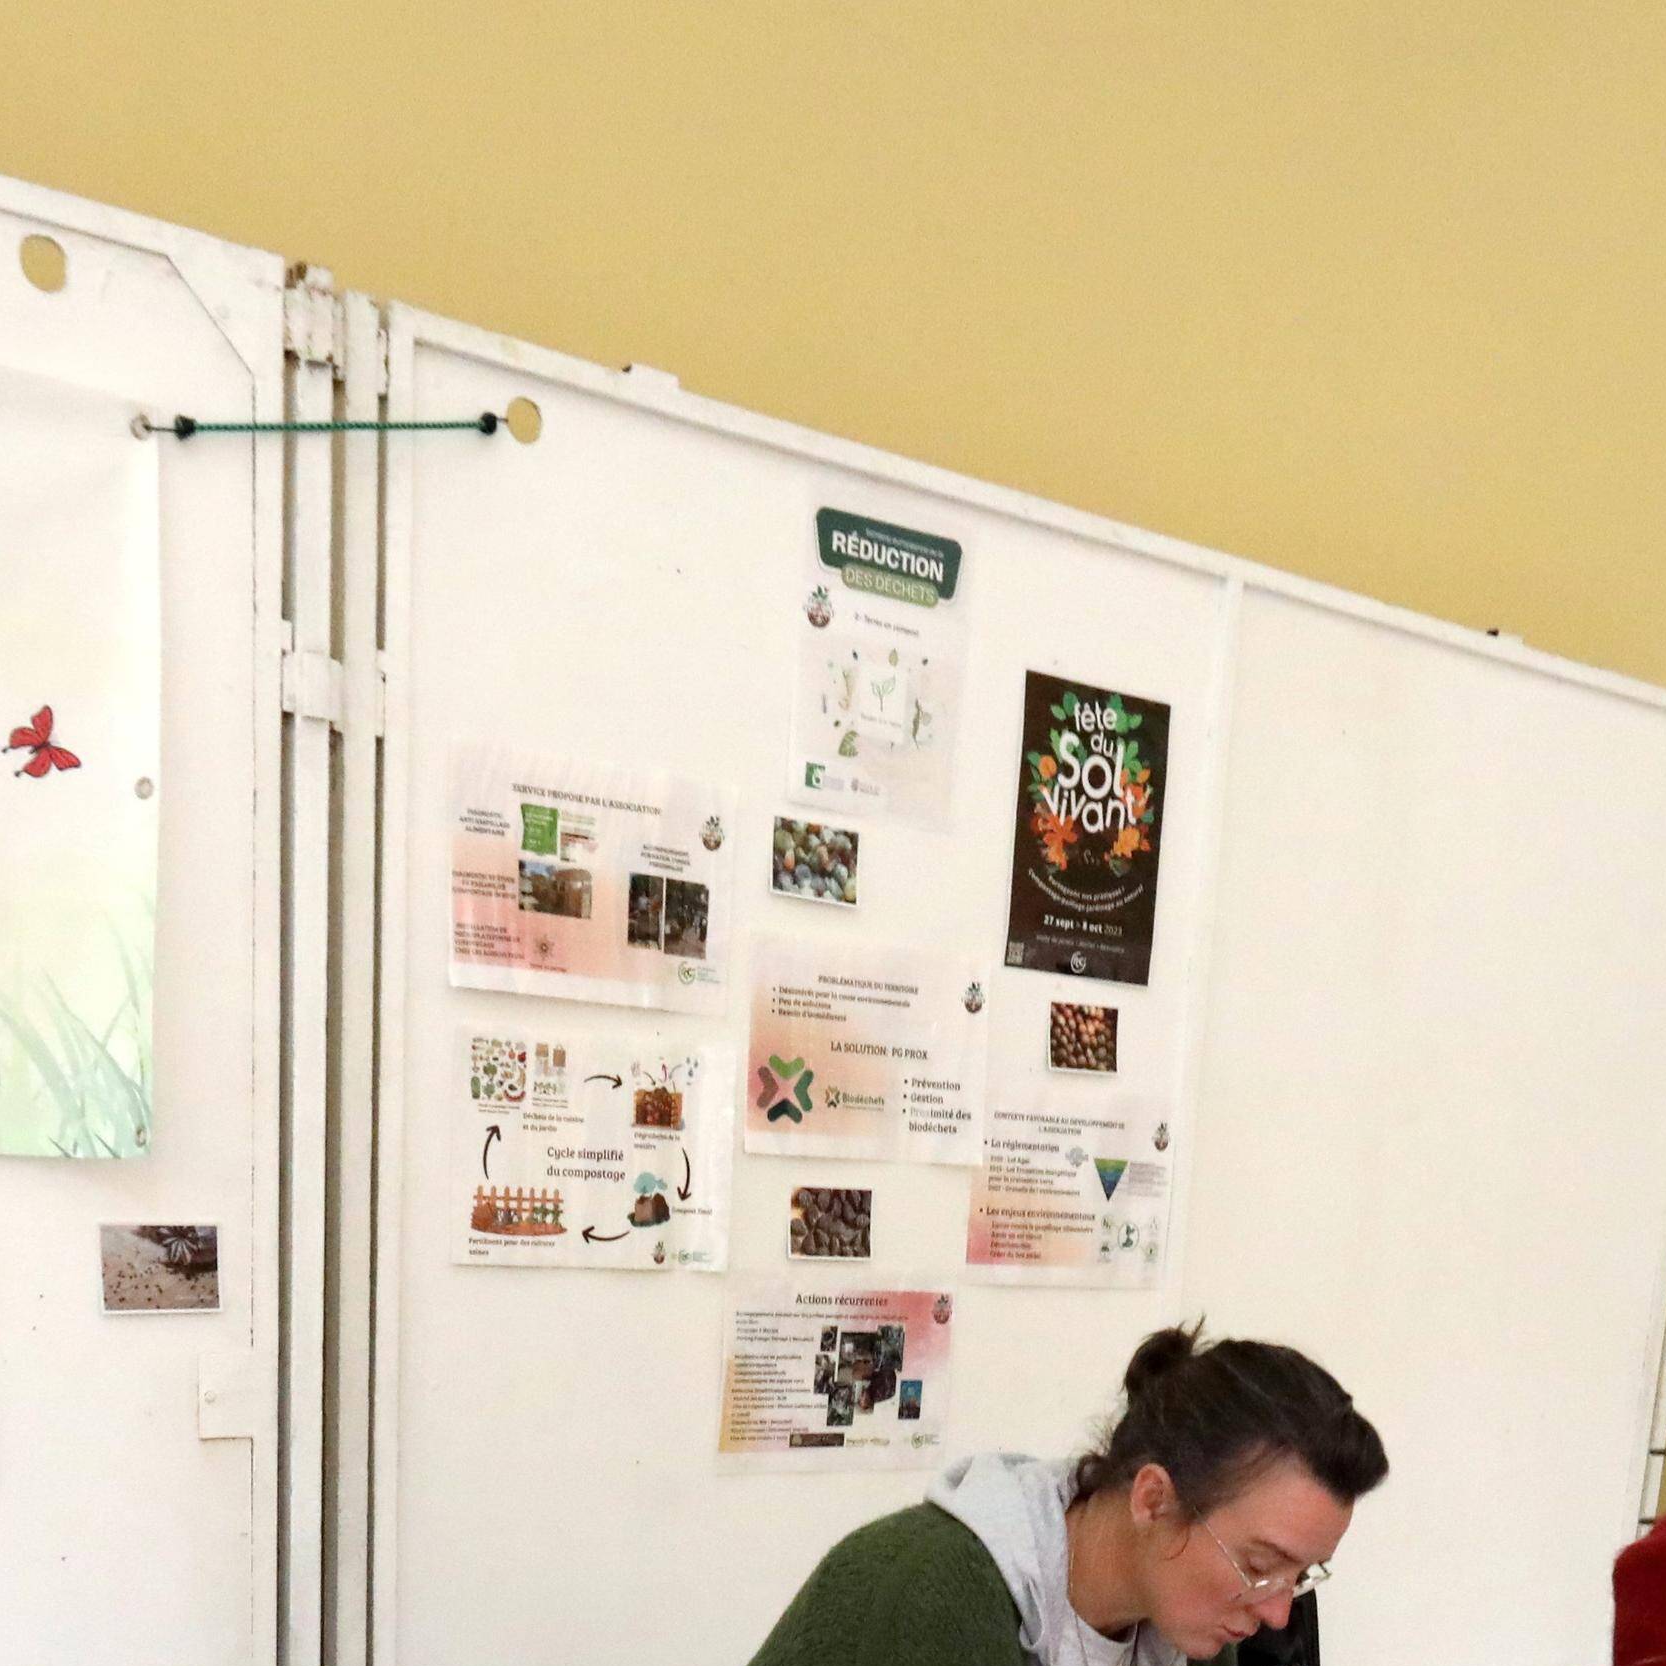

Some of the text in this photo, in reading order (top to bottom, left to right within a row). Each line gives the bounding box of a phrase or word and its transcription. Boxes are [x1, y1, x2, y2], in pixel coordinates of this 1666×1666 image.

[832, 529, 945, 583] RÉDUCTION
[846, 567, 873, 589] DES
[1091, 730, 1114, 758] du
[1089, 922, 1103, 935] oct
[830, 1041, 843, 1053] LA
[891, 1047, 903, 1059] PG
[904, 1049, 928, 1061] PROX
[911, 1078, 961, 1092] Prévention
[910, 1093, 944, 1105] Gestion
[955, 1110, 972, 1121] des
[908, 1121, 958, 1135] biodéchets
[990, 1139, 1000, 1148] La
[546, 1146, 625, 1163] Cycle simplifié
[546, 1165, 627, 1182] du compostage
[986, 1206, 999, 1217] Les
[1000, 1208, 1026, 1219] enjeux
[795, 1293, 889, 1308] Actions récurrentes
